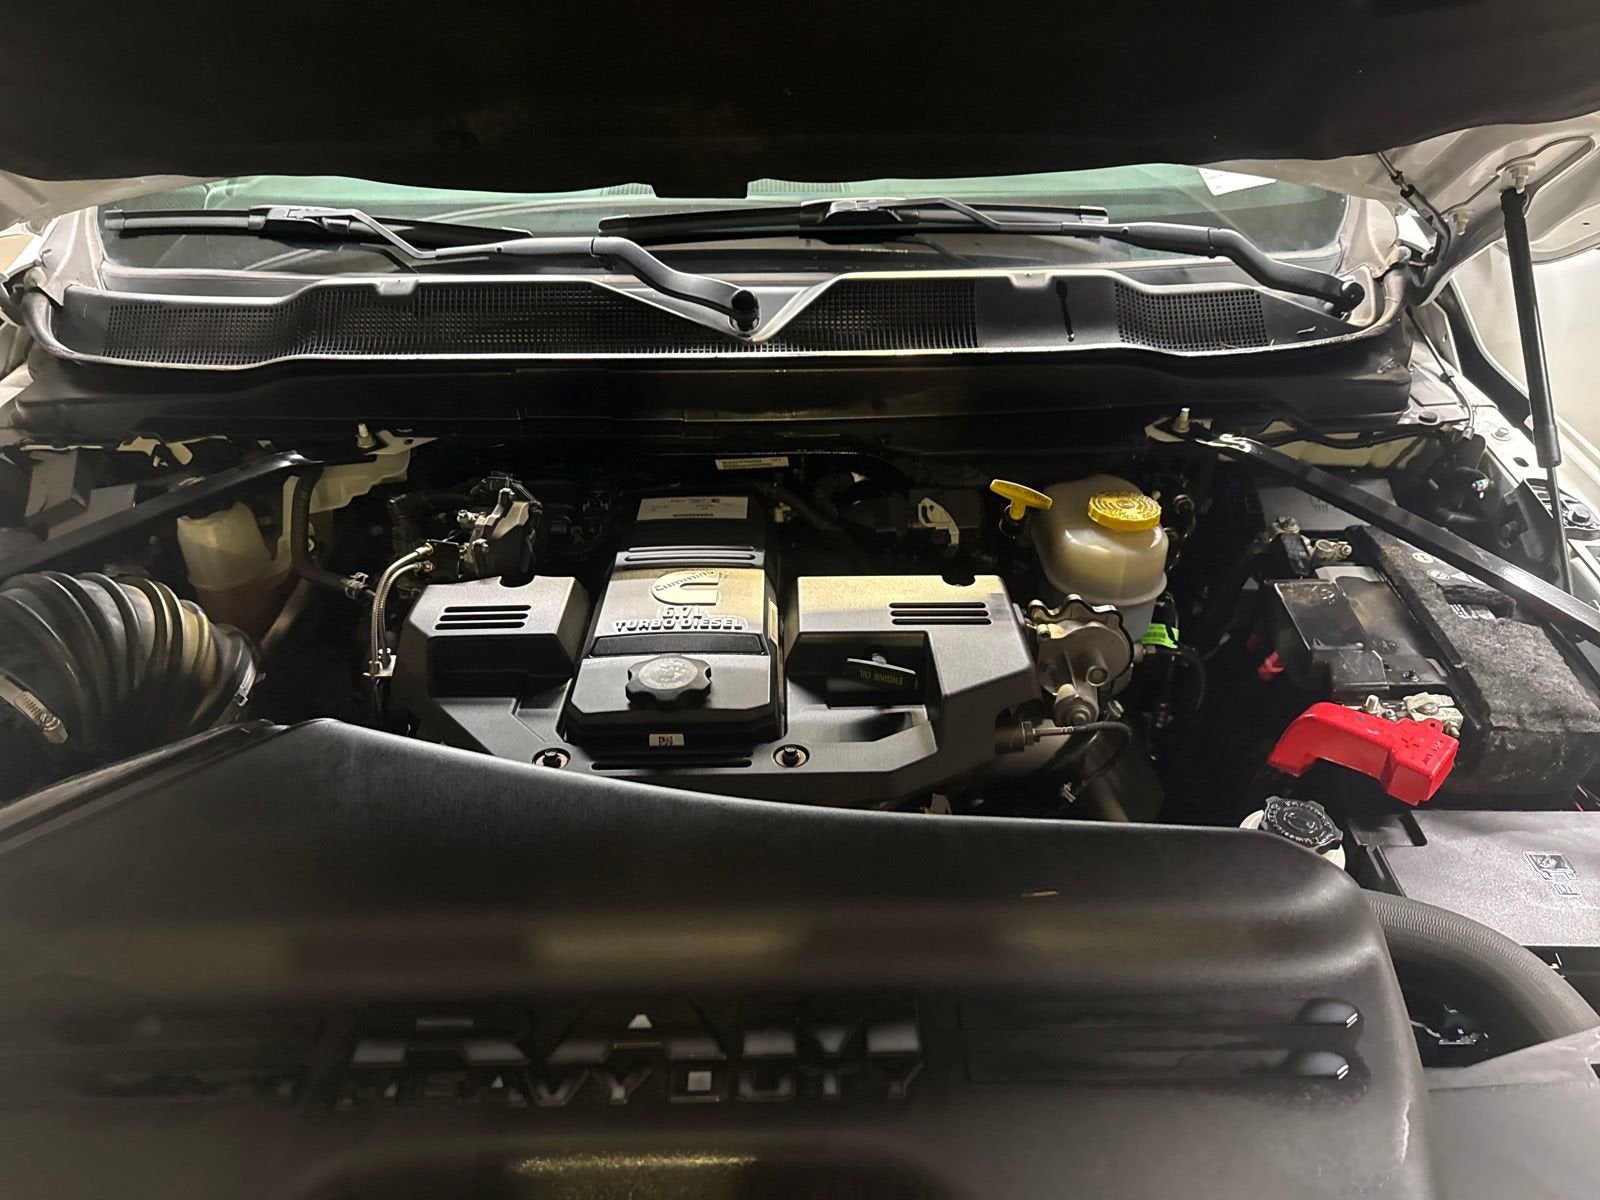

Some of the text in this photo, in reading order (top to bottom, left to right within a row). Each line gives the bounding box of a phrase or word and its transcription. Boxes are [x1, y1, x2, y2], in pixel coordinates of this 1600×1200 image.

[614, 617, 745, 632] TURBO DIESEL
[860, 670, 903, 685] ENGINE OIL
